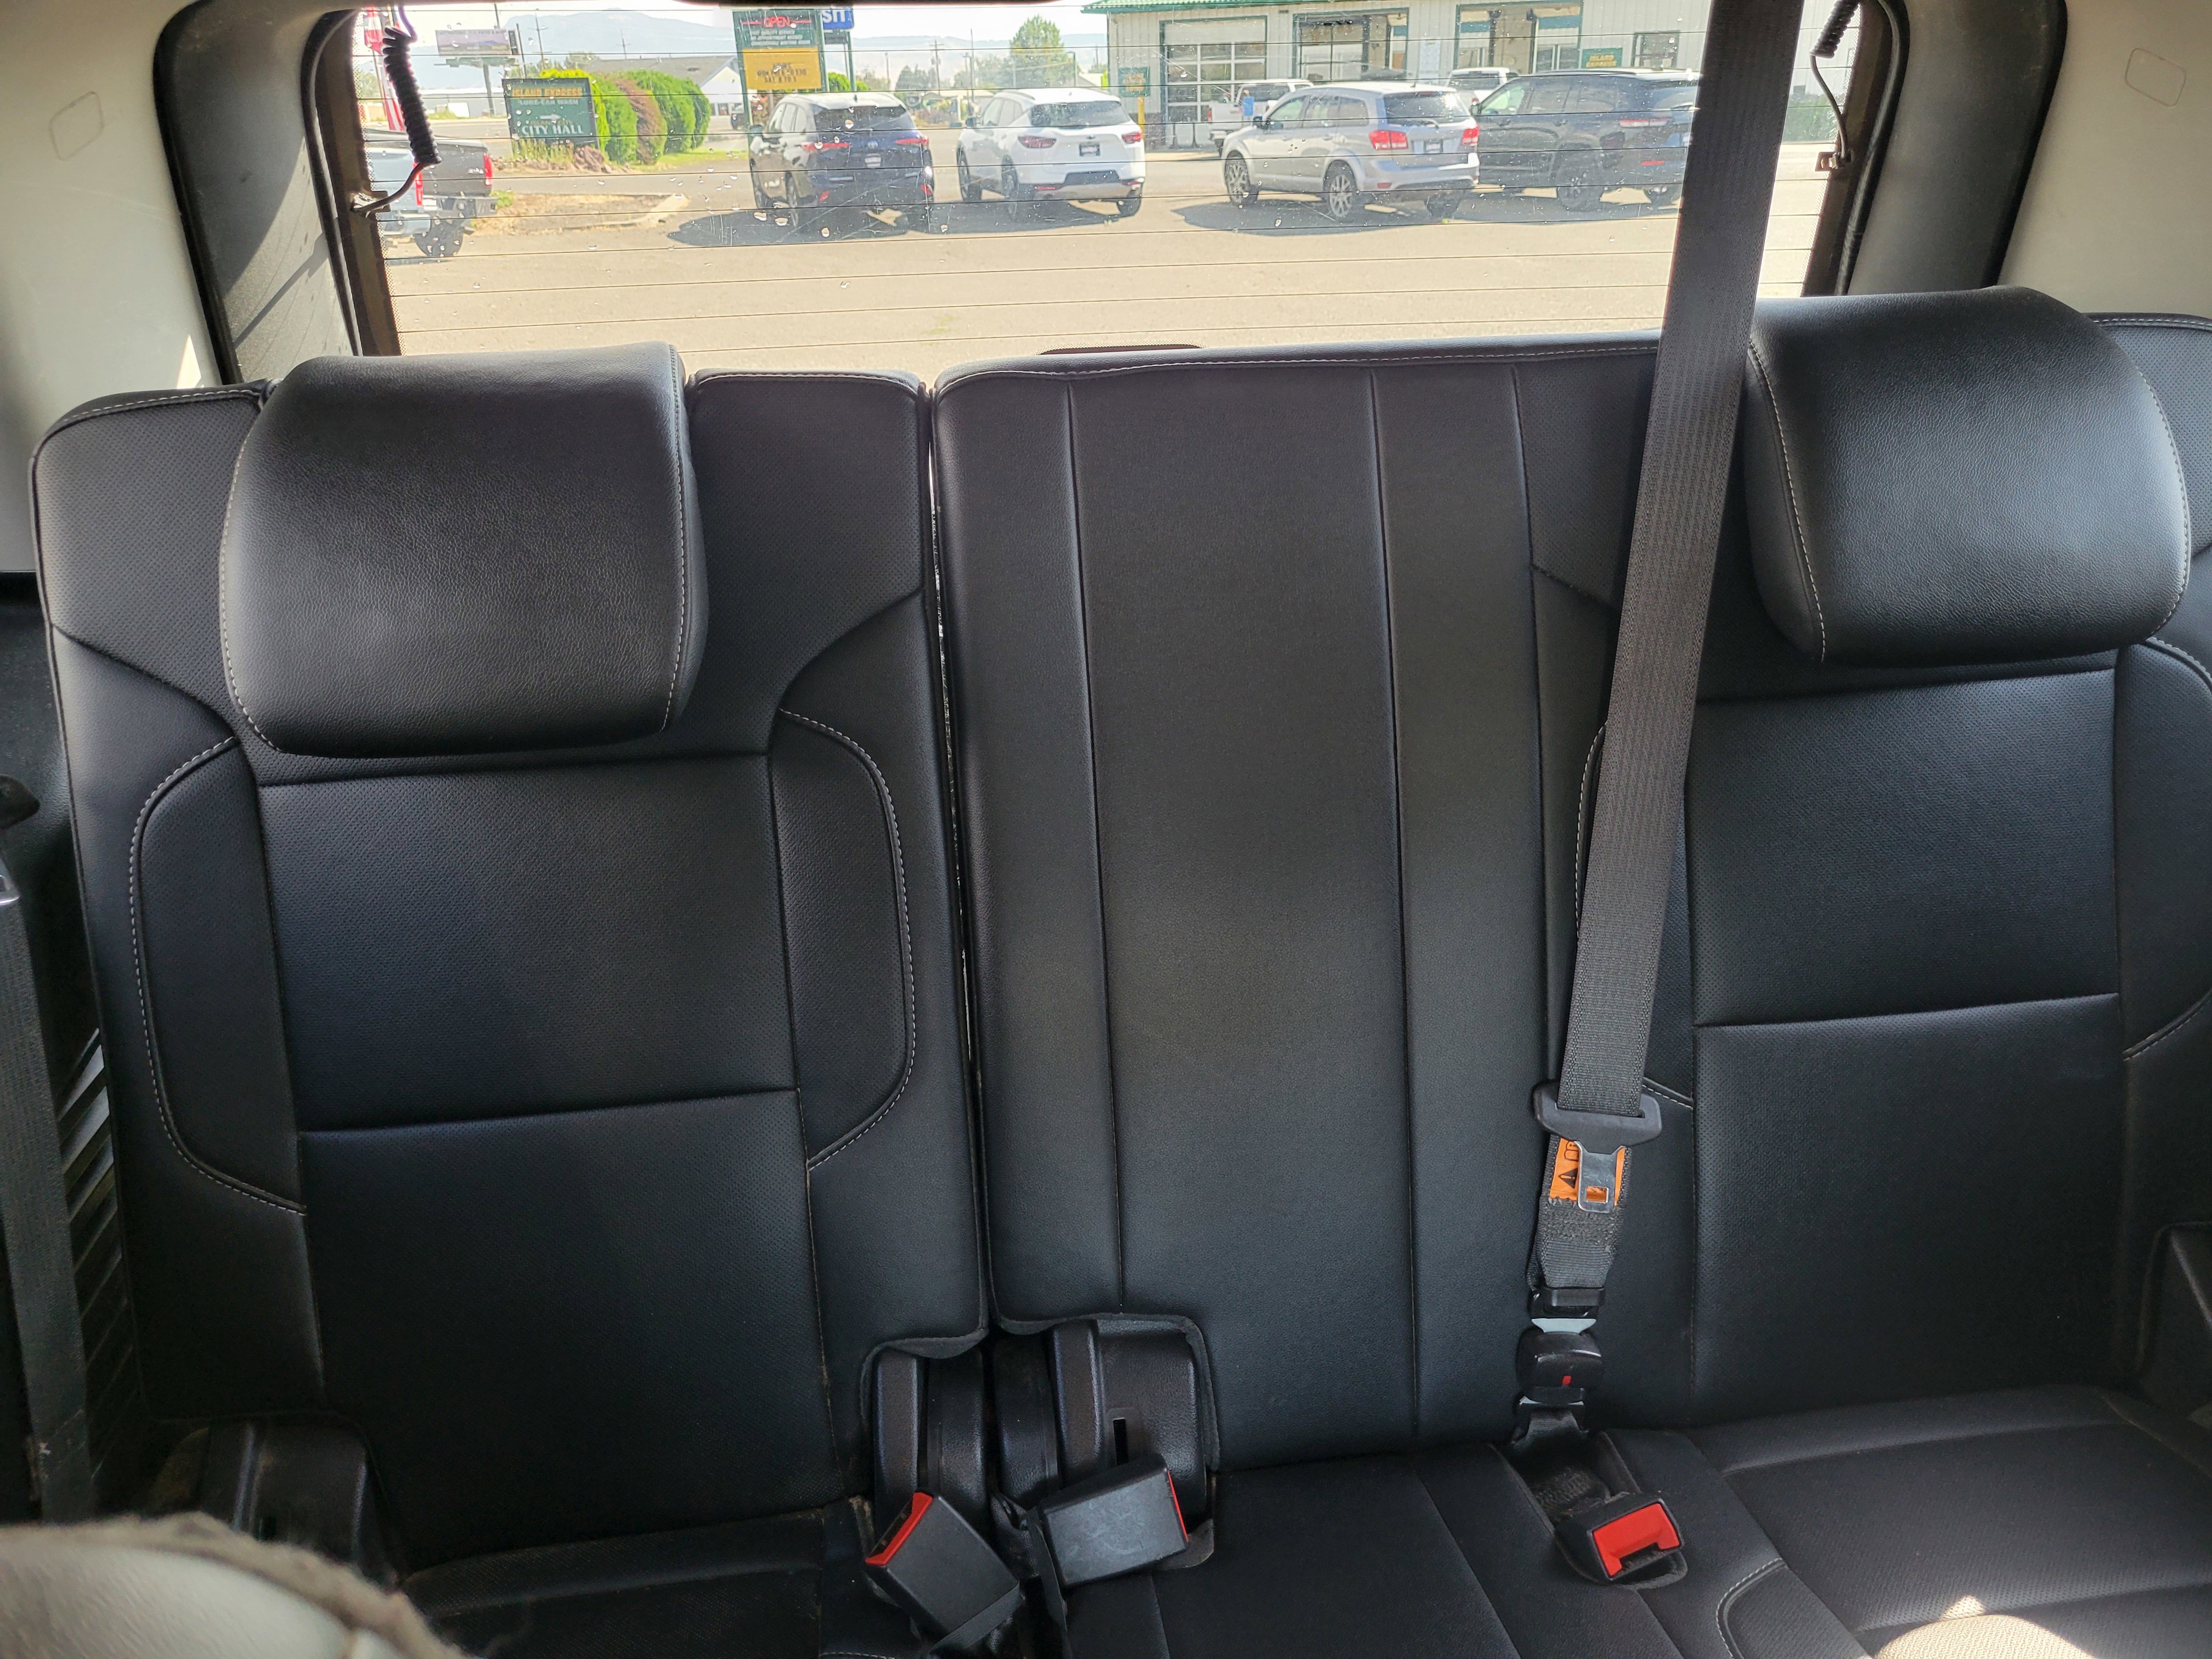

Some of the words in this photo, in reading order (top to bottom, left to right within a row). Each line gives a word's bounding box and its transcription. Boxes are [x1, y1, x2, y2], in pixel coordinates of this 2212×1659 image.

[764, 16, 791, 27] OPEN
[522, 125, 548, 135] CITY
[552, 125, 584, 134] HALL
